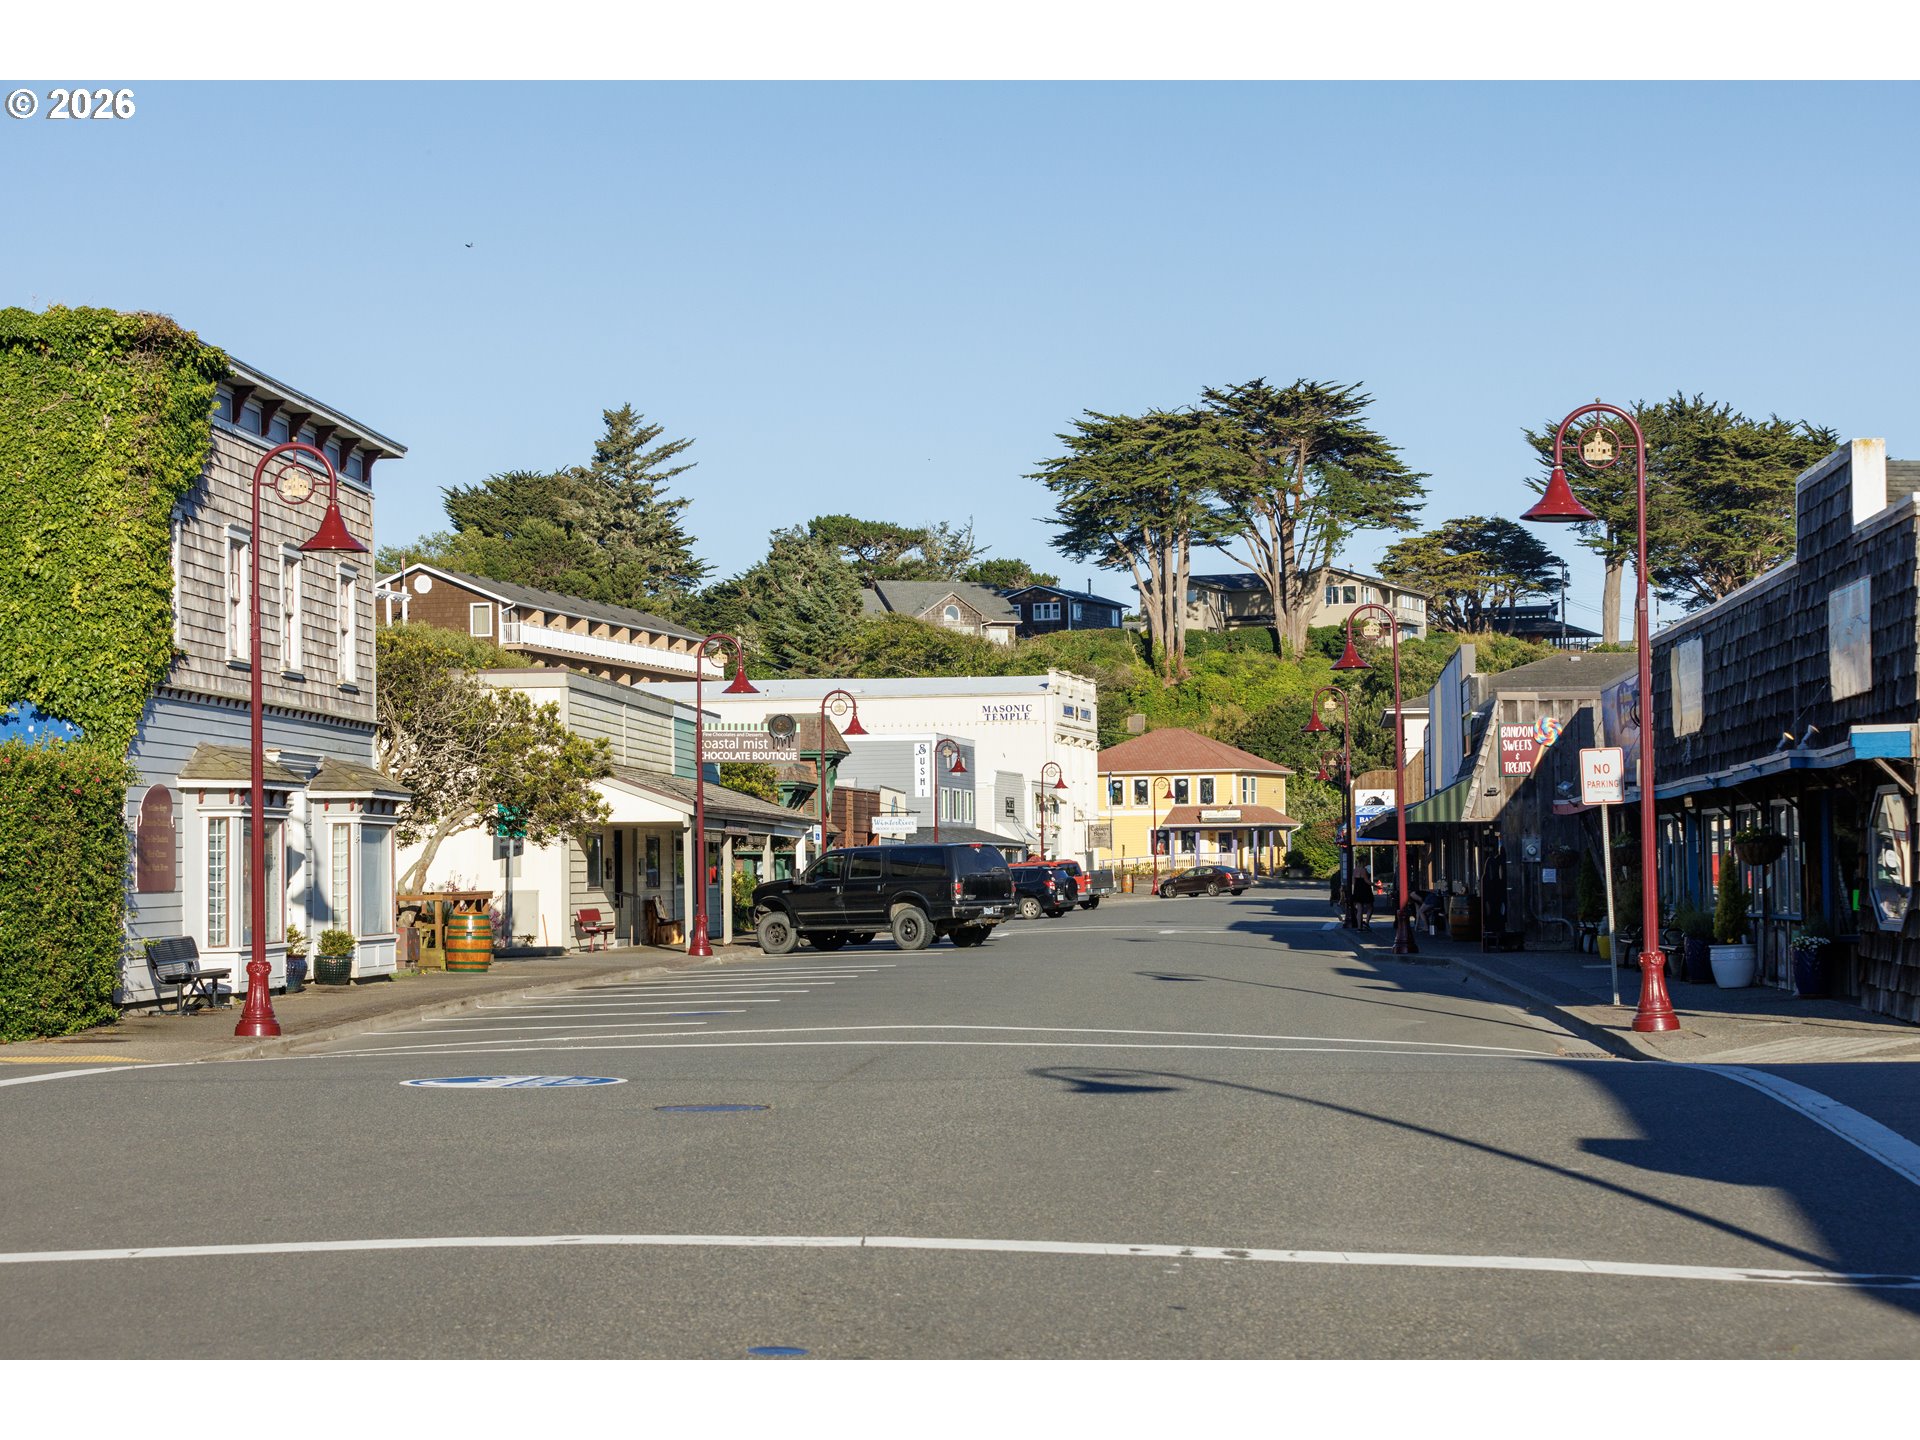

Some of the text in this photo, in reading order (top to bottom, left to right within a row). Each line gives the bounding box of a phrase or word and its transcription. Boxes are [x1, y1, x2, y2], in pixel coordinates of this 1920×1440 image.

[982, 704, 1032, 713] MASONIC
[984, 713, 1030, 721] TEMPLE
[1500, 726, 1534, 738] BANDON
[743, 738, 769, 749] mist
[1502, 739, 1532, 751] SWEETS
[752, 751, 798, 761] BOUTIQUE
[915, 744, 927, 797] SUSHI
[1504, 761, 1532, 774] TREATS
[1593, 763, 1611, 775] NO
[1587, 779, 1619, 789] PARKING
